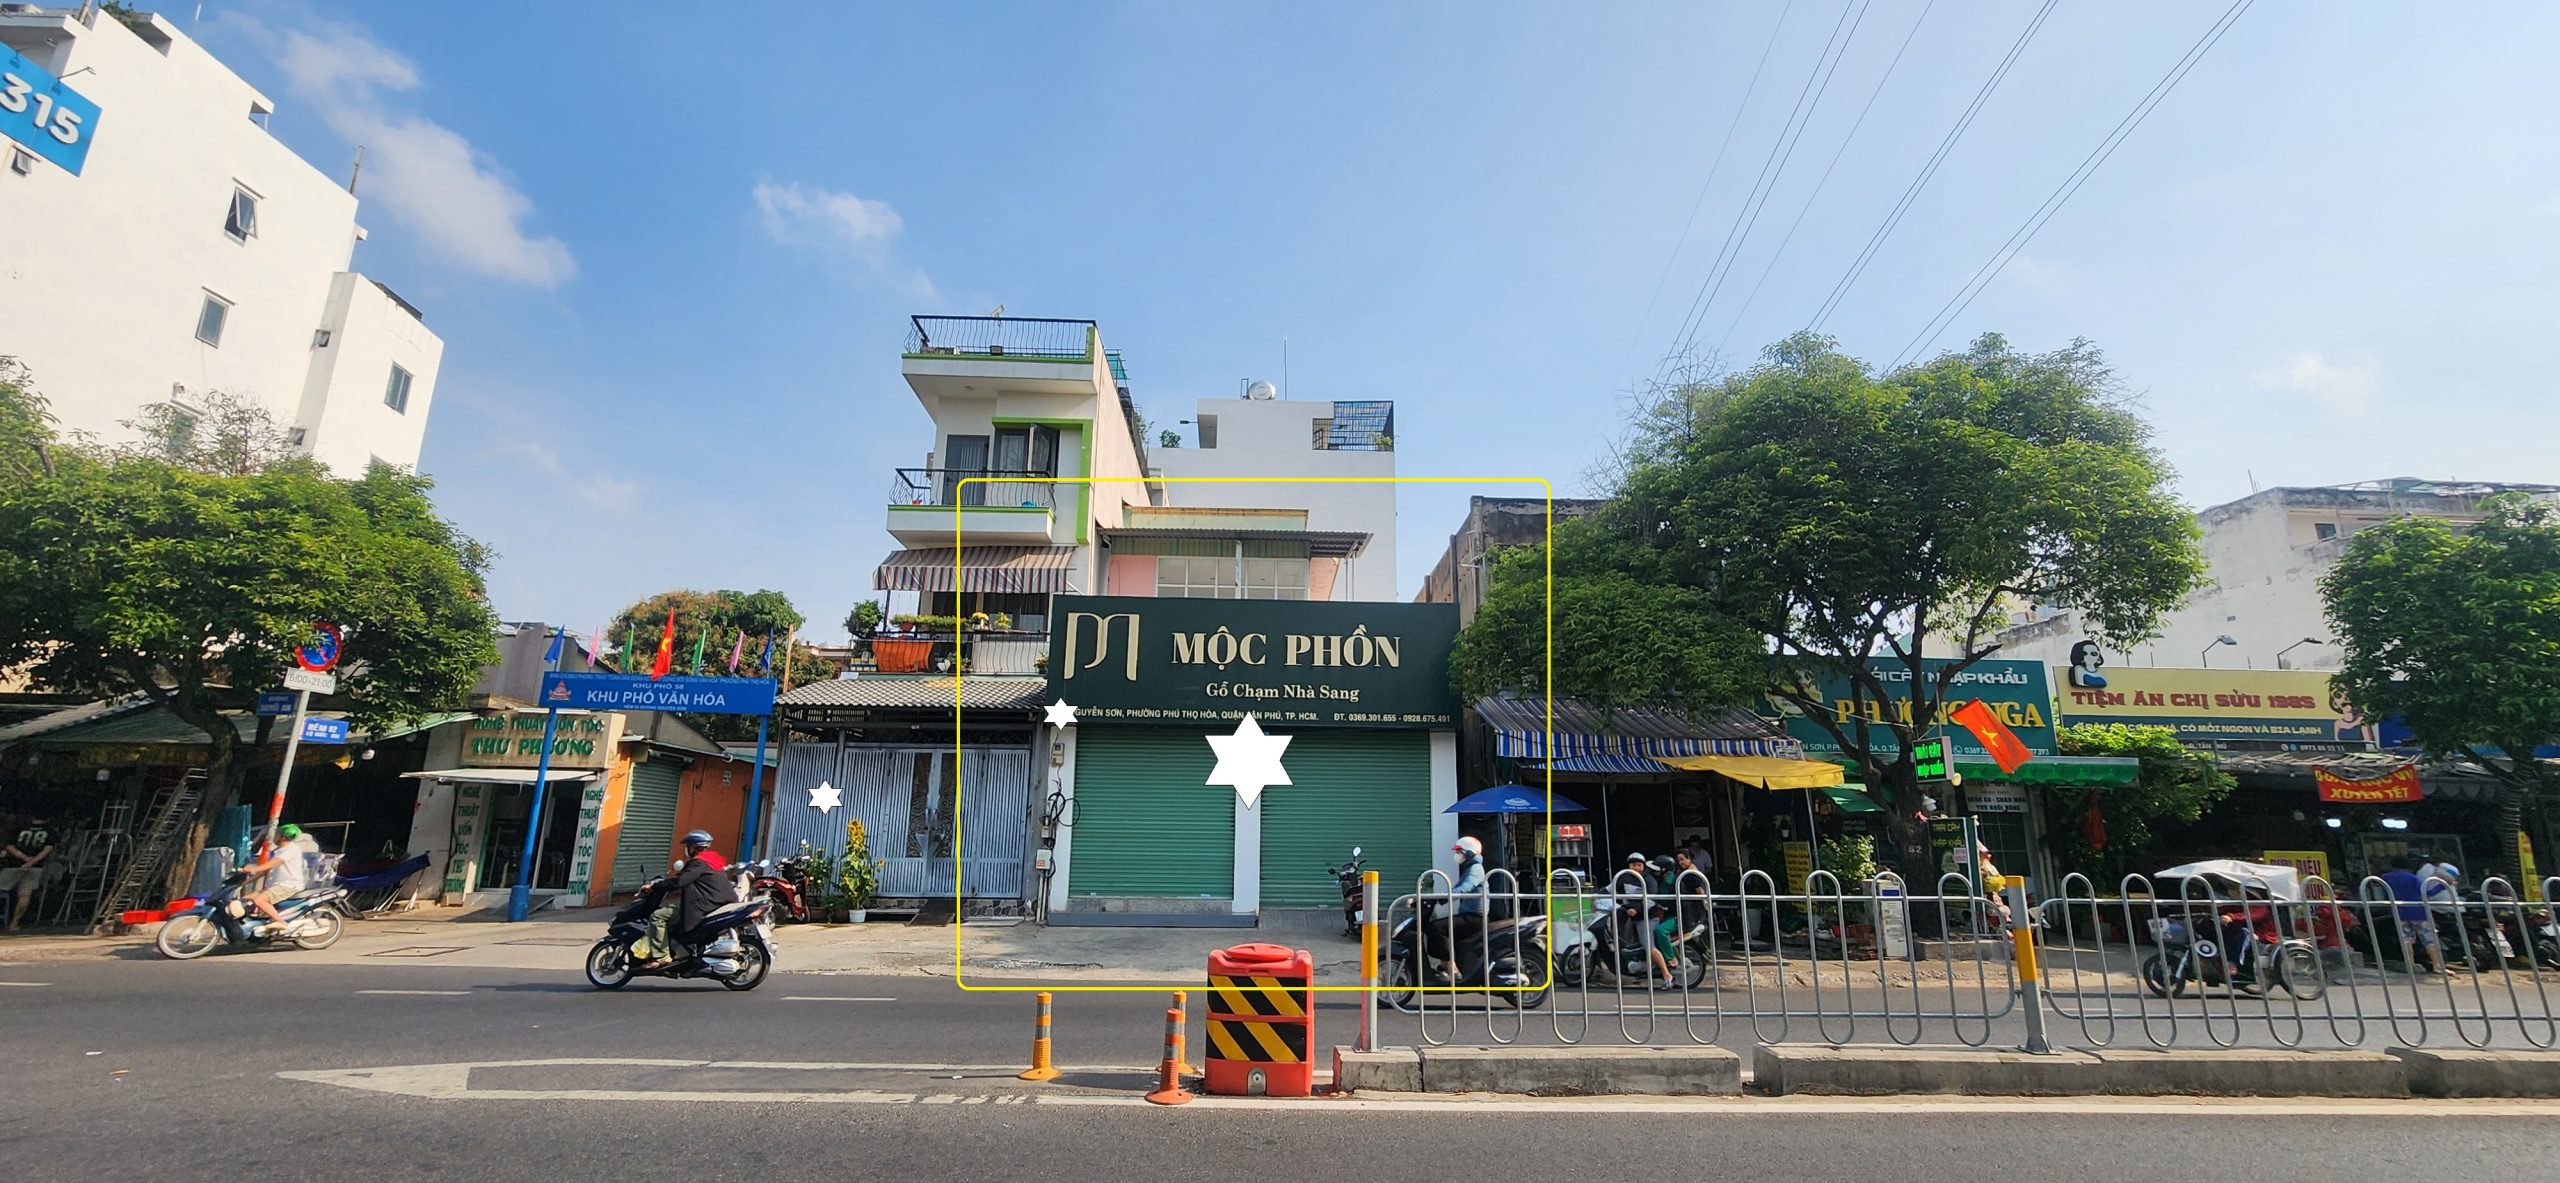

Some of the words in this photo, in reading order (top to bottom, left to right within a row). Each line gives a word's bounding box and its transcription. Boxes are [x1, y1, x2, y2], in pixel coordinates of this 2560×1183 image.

[0, 72, 82, 144] 315
[1171, 625, 1267, 671] MỘC
[1284, 623, 1401, 668] PHỒN
[1979, 667, 2028, 684] KHẨU
[587, 690, 618, 703] KHU
[622, 689, 655, 704] PHỐ
[659, 690, 689, 705] VĂN
[693, 691, 725, 706] HÓA
[1206, 682, 1229, 697] Gỗ
[1233, 683, 1280, 702] Chạm
[1283, 684, 1315, 699] Nhà
[1319, 686, 1360, 702] Sang
[2070, 690, 2126, 708] TIỆM
[2133, 690, 2165, 706] ĂN
[2170, 693, 2210, 710] CHỊ
[1074, 706, 1103, 717] GUYỄN
[1105, 707, 1125, 719] SƠN,
[1126, 707, 1161, 718] PHƯỜNG
[1163, 708, 1180, 718] PHÚ
[1182, 710, 1199, 720] THỌ
[1200, 709, 1220, 720] HÒA,
[1221, 709, 1244, 721] QUẬN
[1264, 710, 1283, 721] PHÚ,
[1285, 711, 1297, 721] TP.
[1299, 712, 1319, 721] HCM.
[1333, 712, 1347, 721] ĐT.
[1348, 713, 1397, 722] 0369.301.655
[472, 738, 511, 755] THƯ
[518, 736, 596, 756] PHƠNG
